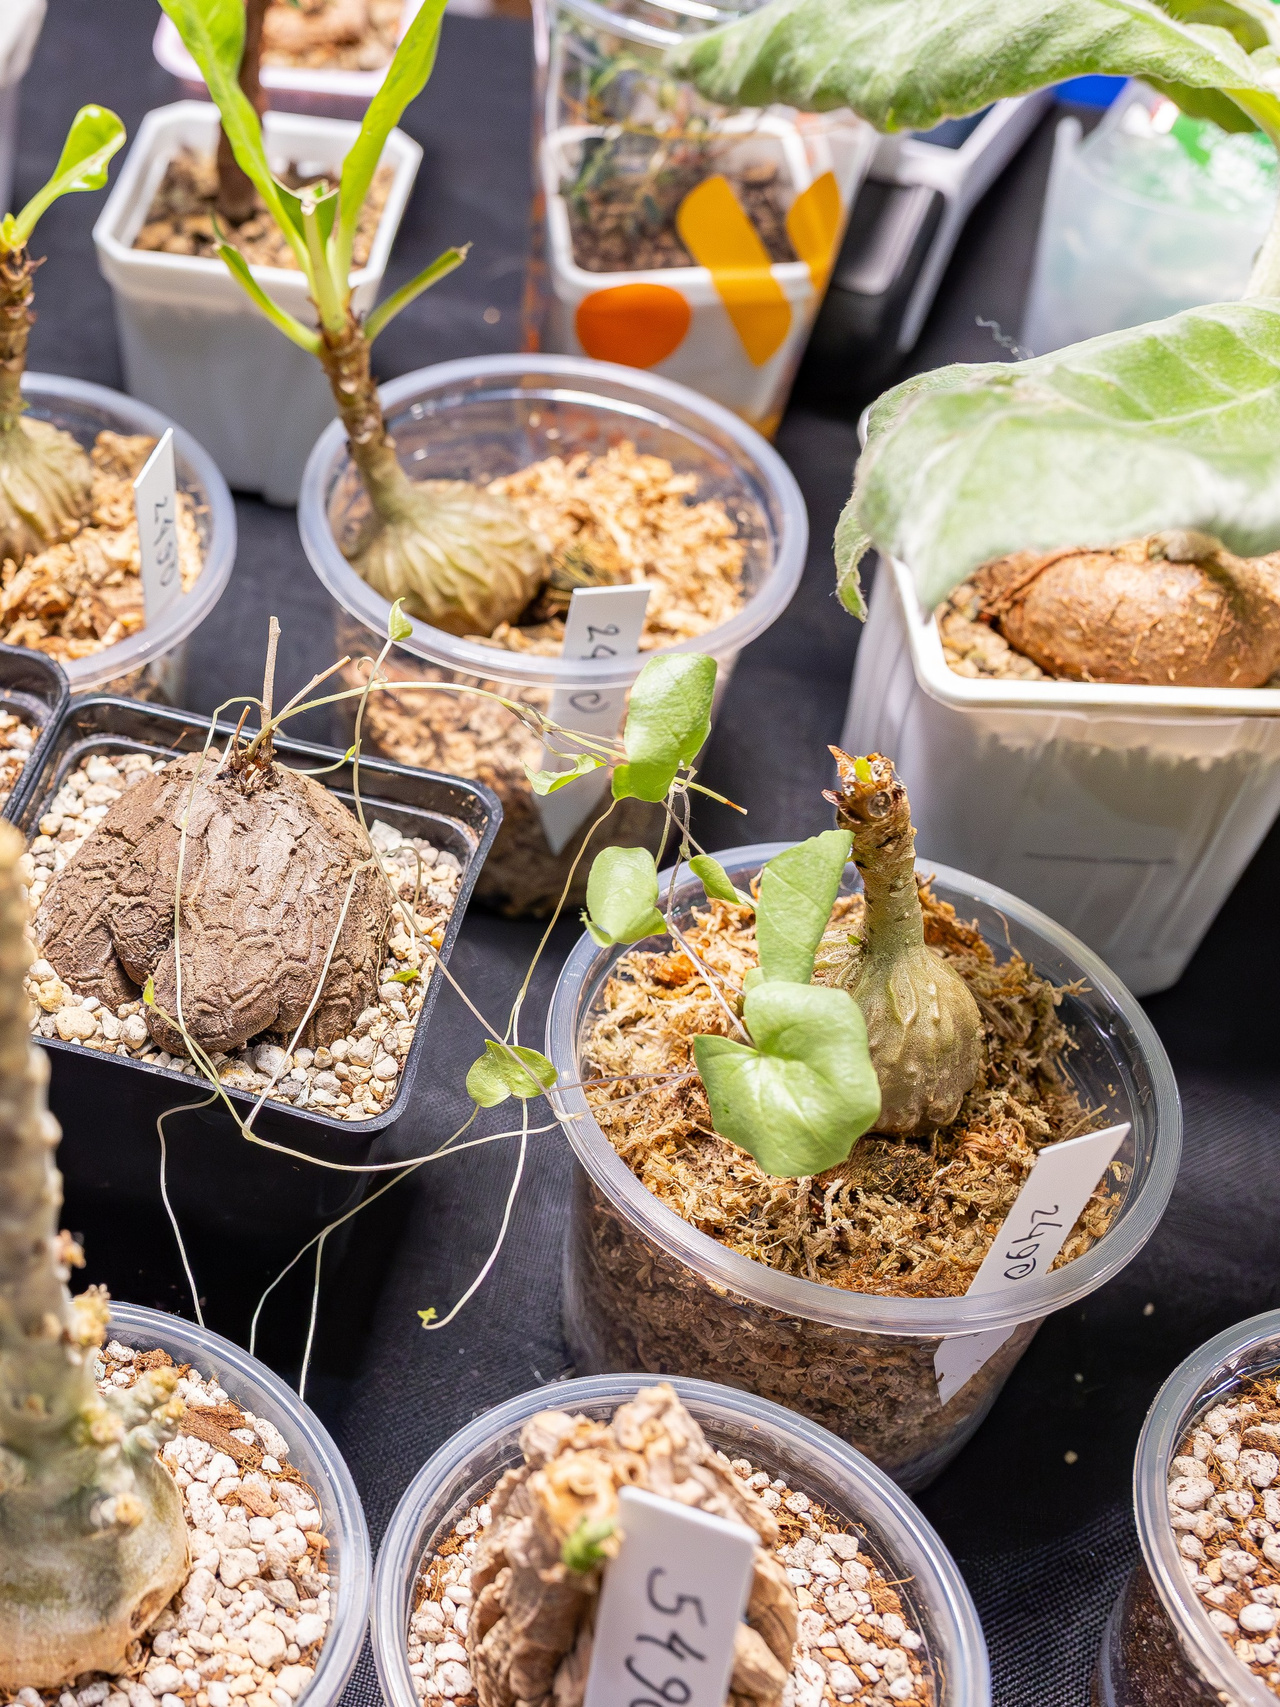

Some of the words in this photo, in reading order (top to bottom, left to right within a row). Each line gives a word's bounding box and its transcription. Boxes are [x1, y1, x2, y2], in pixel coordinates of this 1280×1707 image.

[568, 623, 620, 714] 240
[1003, 1204, 1063, 1280] 2490
[624, 1566, 707, 1707] 549
